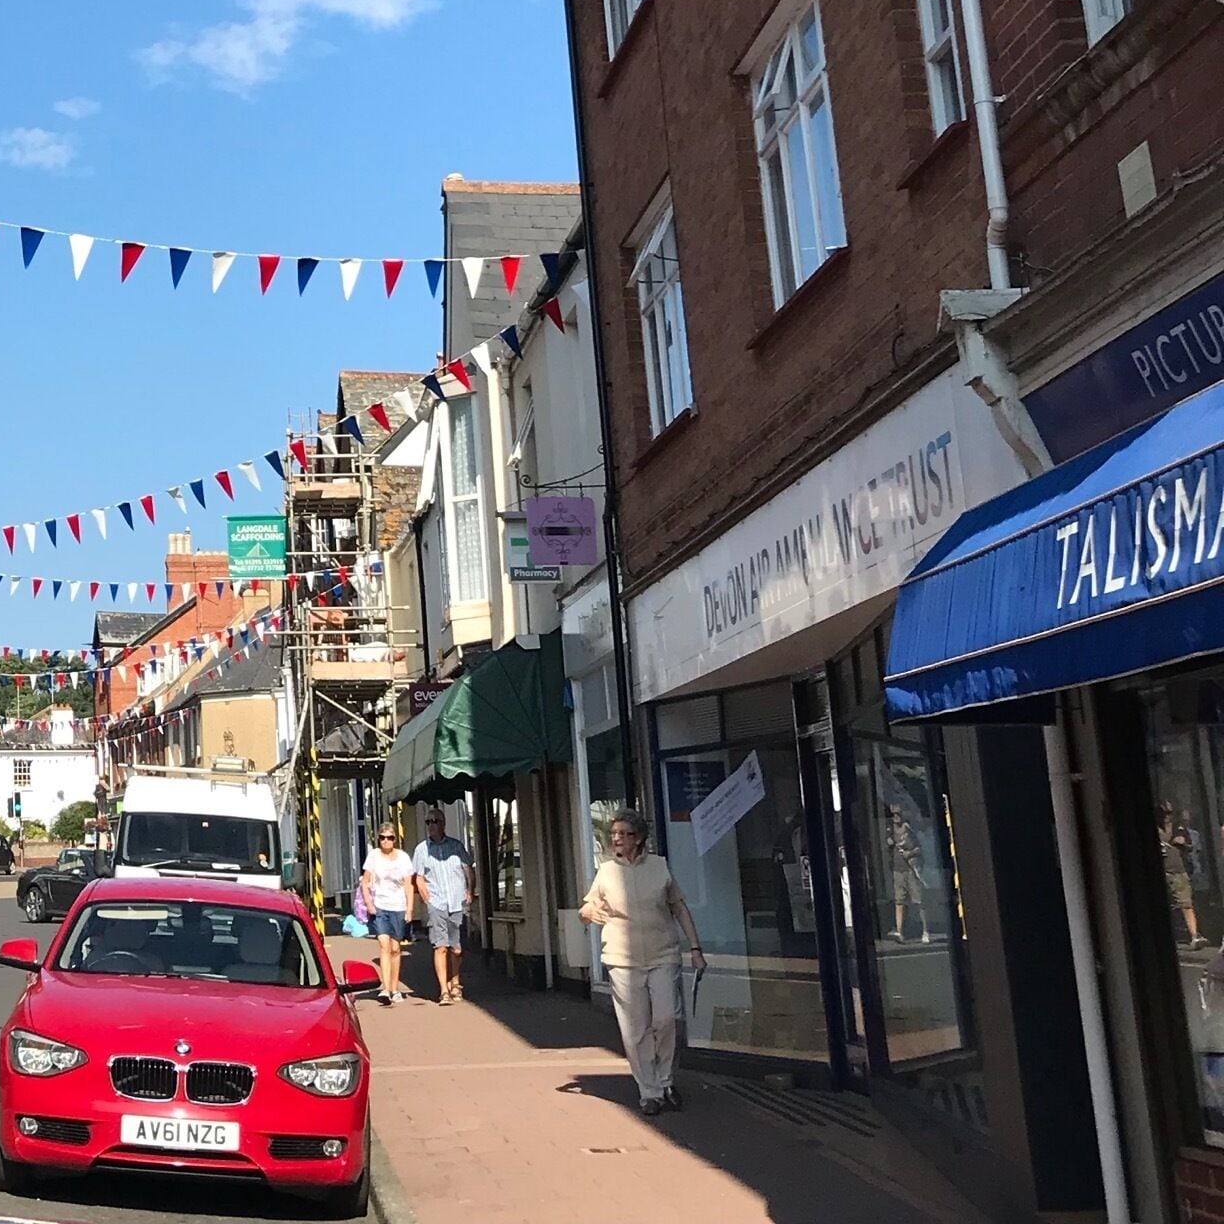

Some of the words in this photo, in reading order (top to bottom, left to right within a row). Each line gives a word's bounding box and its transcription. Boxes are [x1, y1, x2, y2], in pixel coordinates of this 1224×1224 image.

[236, 524, 278, 533] LANGDALE
[231, 533, 285, 542] SCAFFOLDING
[514, 568, 558, 580] Pharmacy
[703, 562, 748, 638] DEVON
[137, 1120, 180, 1142] AV61
[187, 1123, 226, 1145] NZG
